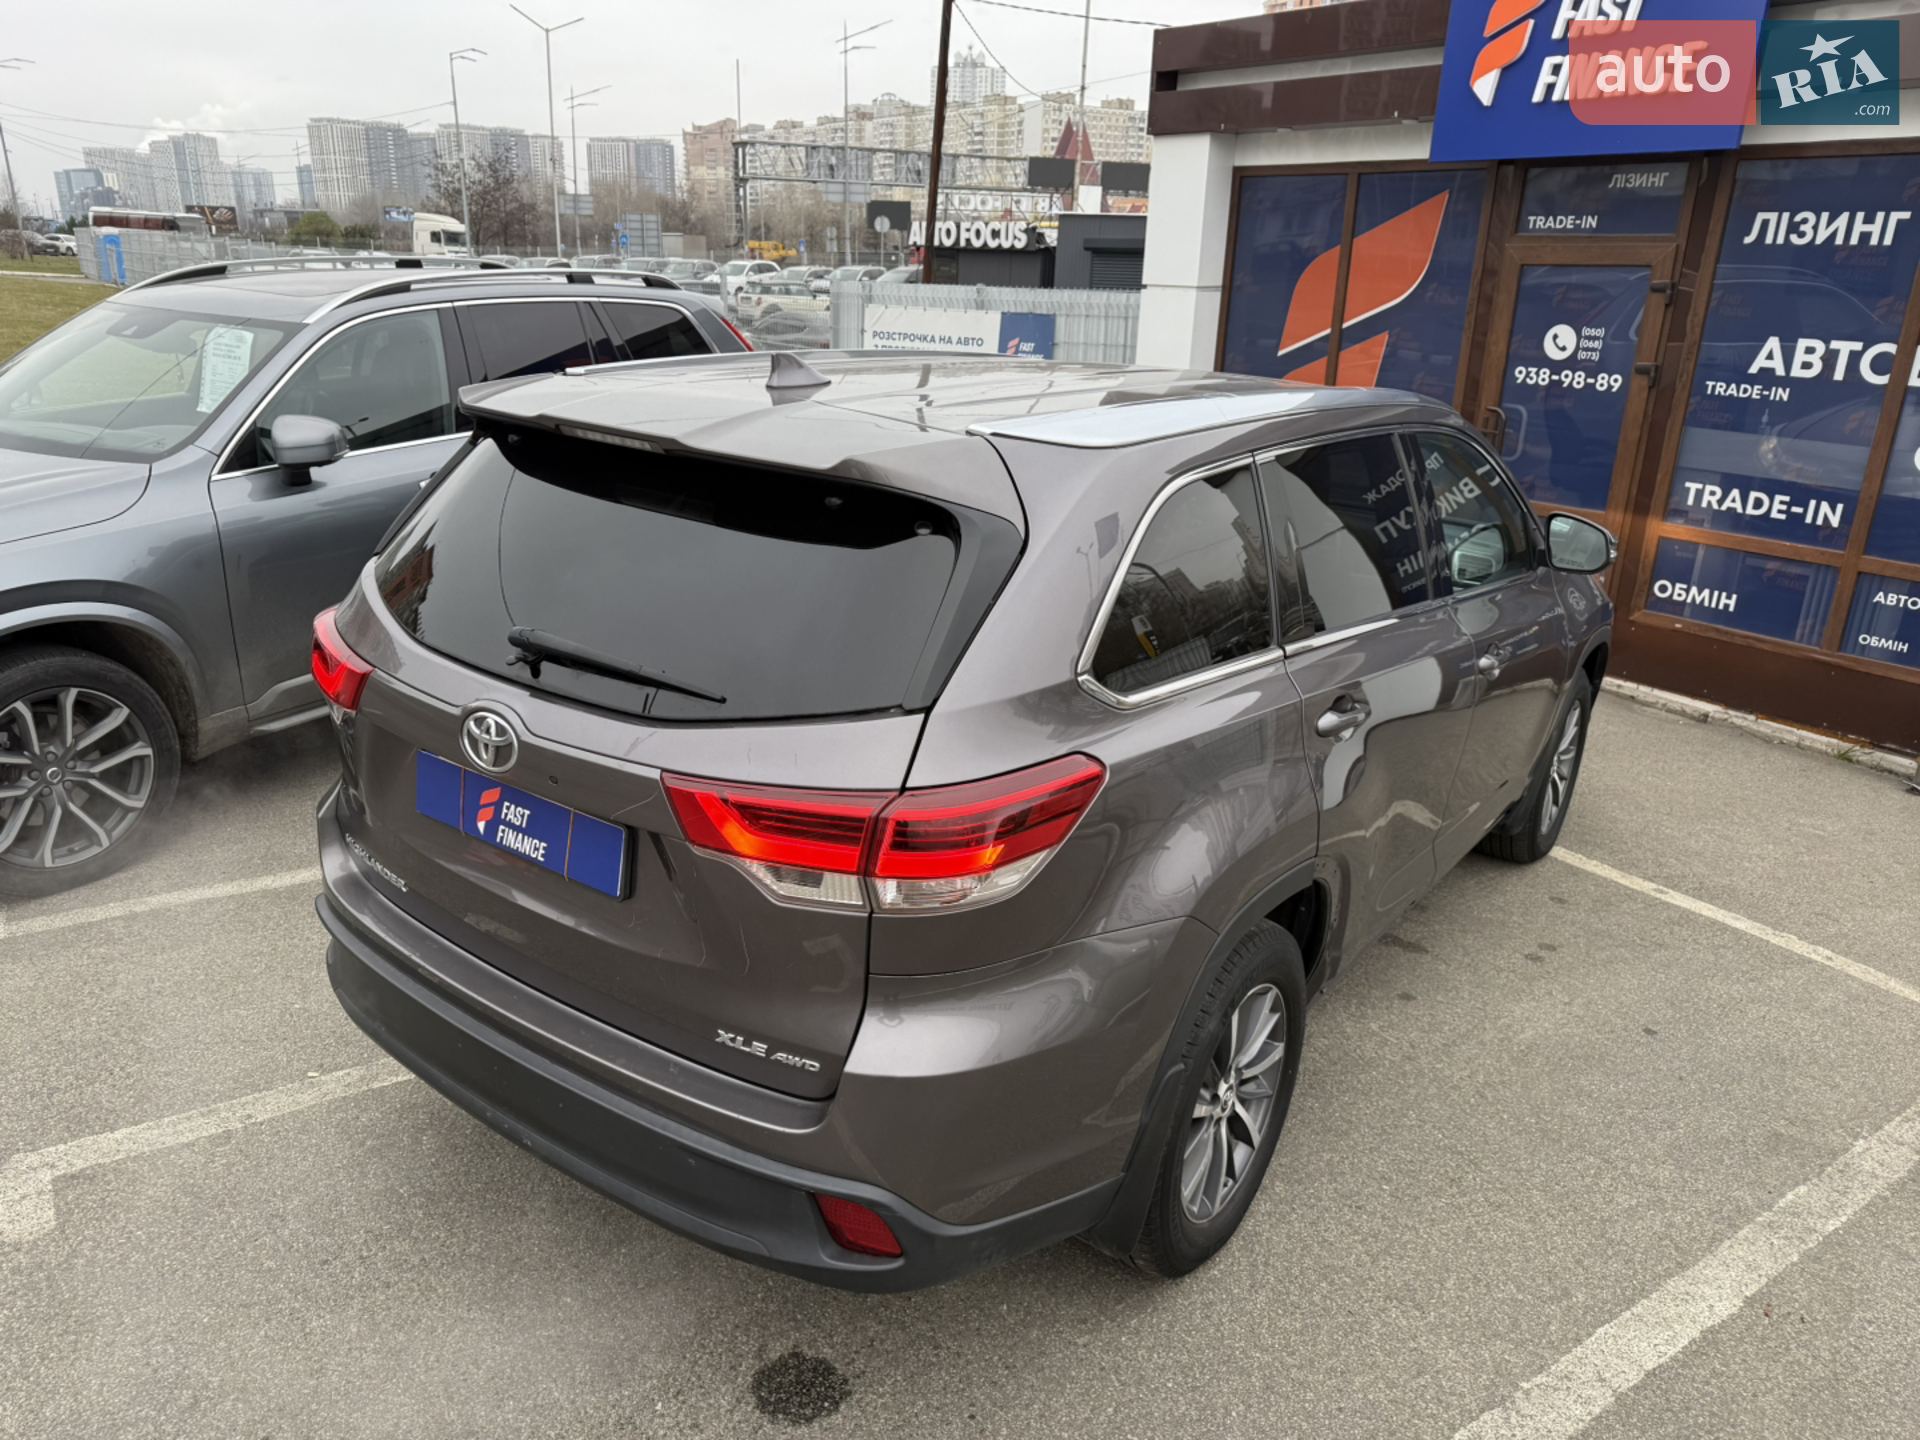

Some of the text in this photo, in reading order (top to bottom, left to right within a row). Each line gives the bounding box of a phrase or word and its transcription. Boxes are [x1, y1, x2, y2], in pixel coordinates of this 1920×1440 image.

[1608, 172, 1669, 189] ЛІЗИНГ
[1527, 215, 1598, 229] TRADE-IN
[1742, 210, 1912, 246] ЛІЗИНГ
[959, 220, 1029, 249] FOCUS
[872, 330, 984, 348] РОЗСТРОЧКА НА АВТО
[1582, 326, 1605, 338] (050)
[1018, 341, 1036, 352] FAST
[1579, 338, 1603, 350] (068)
[1577, 349, 1600, 362] (073)
[1514, 366, 1622, 393] 938-98-89
[1705, 381, 1790, 402] TRADE-IN
[1684, 481, 1844, 528] TRADE-IN
[1653, 579, 1738, 612] ОБМІН
[1858, 634, 1909, 653] ОБМІН
[501, 801, 530, 828] FAST
[496, 824, 547, 863] FINANCE
[715, 1029, 821, 1072] XLE AWD
